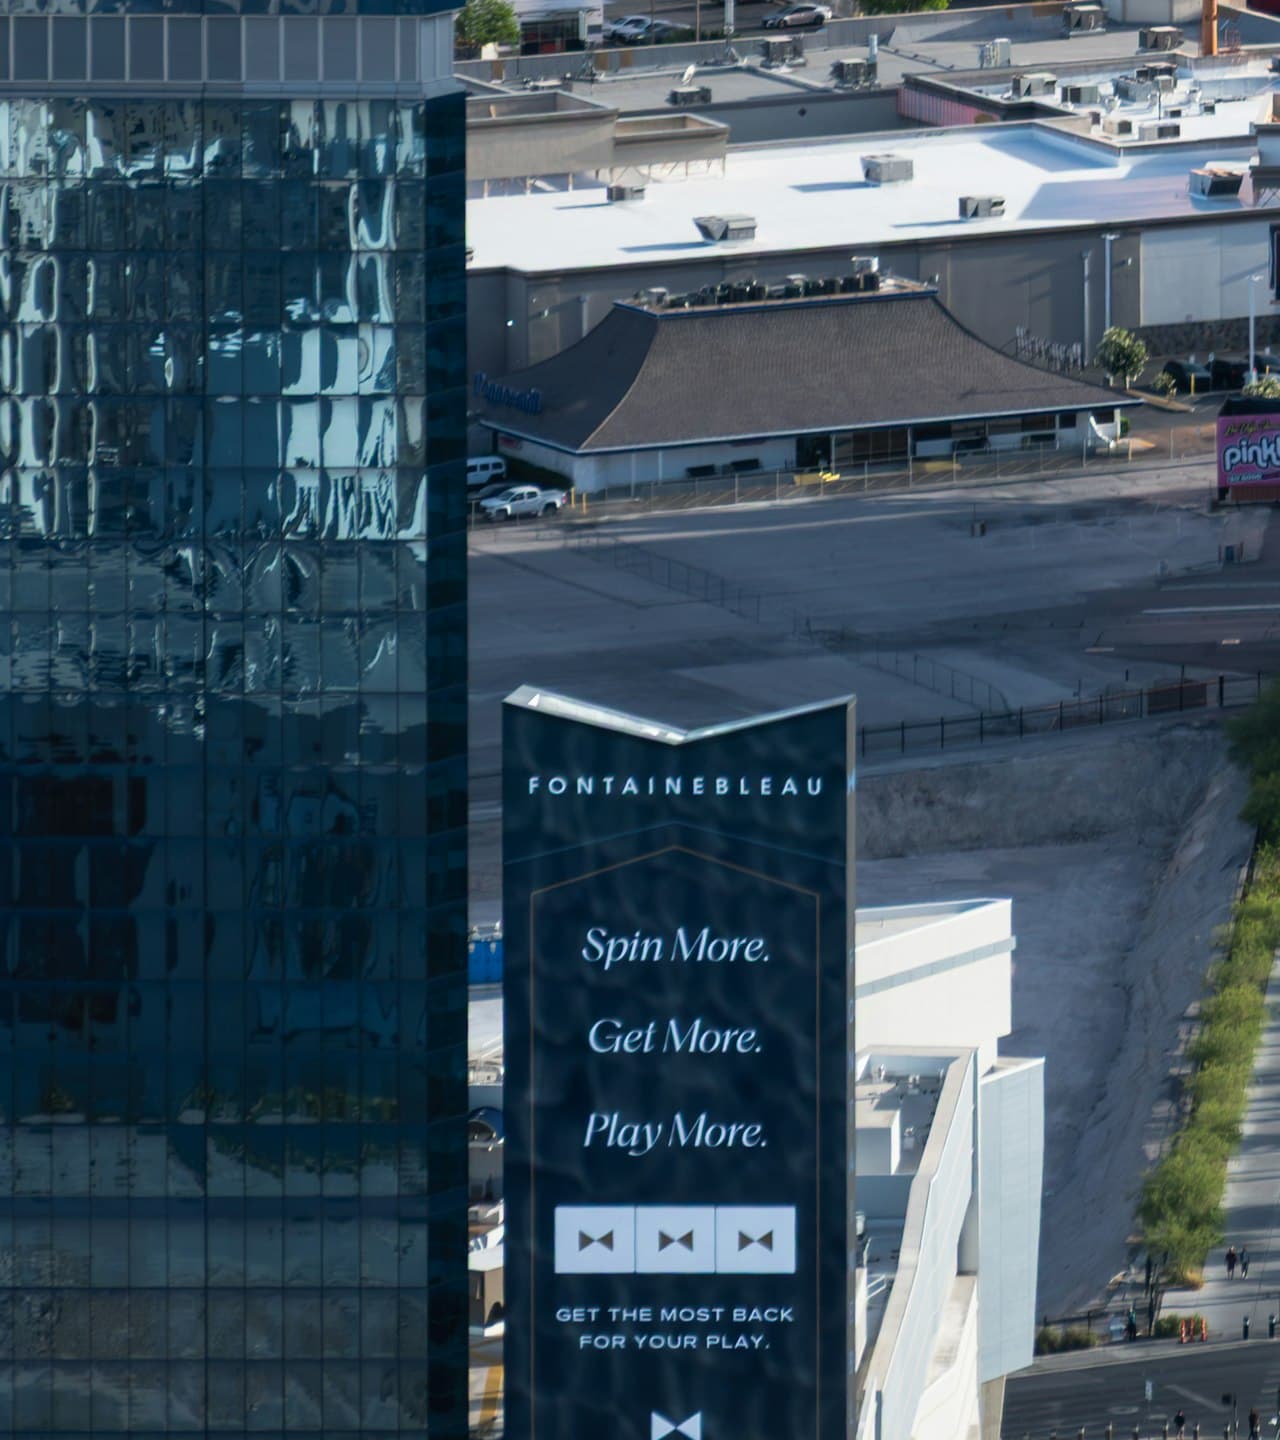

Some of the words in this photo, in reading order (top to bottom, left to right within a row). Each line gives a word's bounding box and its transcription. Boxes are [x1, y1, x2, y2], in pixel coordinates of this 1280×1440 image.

[528, 777, 824, 796] FONTAINEBLEAU
[581, 927, 664, 971] Spin
[670, 927, 770, 963] More.
[588, 1018, 658, 1054] Get
[662, 1018, 762, 1054] More.
[582, 1112, 663, 1157] Play
[667, 1112, 767, 1148] More.
[555, 1308, 600, 1323] GET
[608, 1308, 652, 1323] THE
[659, 1308, 724, 1323] MOST
[732, 1308, 794, 1323] BACK
[578, 1335, 625, 1349] FOR
[634, 1335, 697, 1349] YOUR
[706, 1335, 770, 1350] PLAY.
